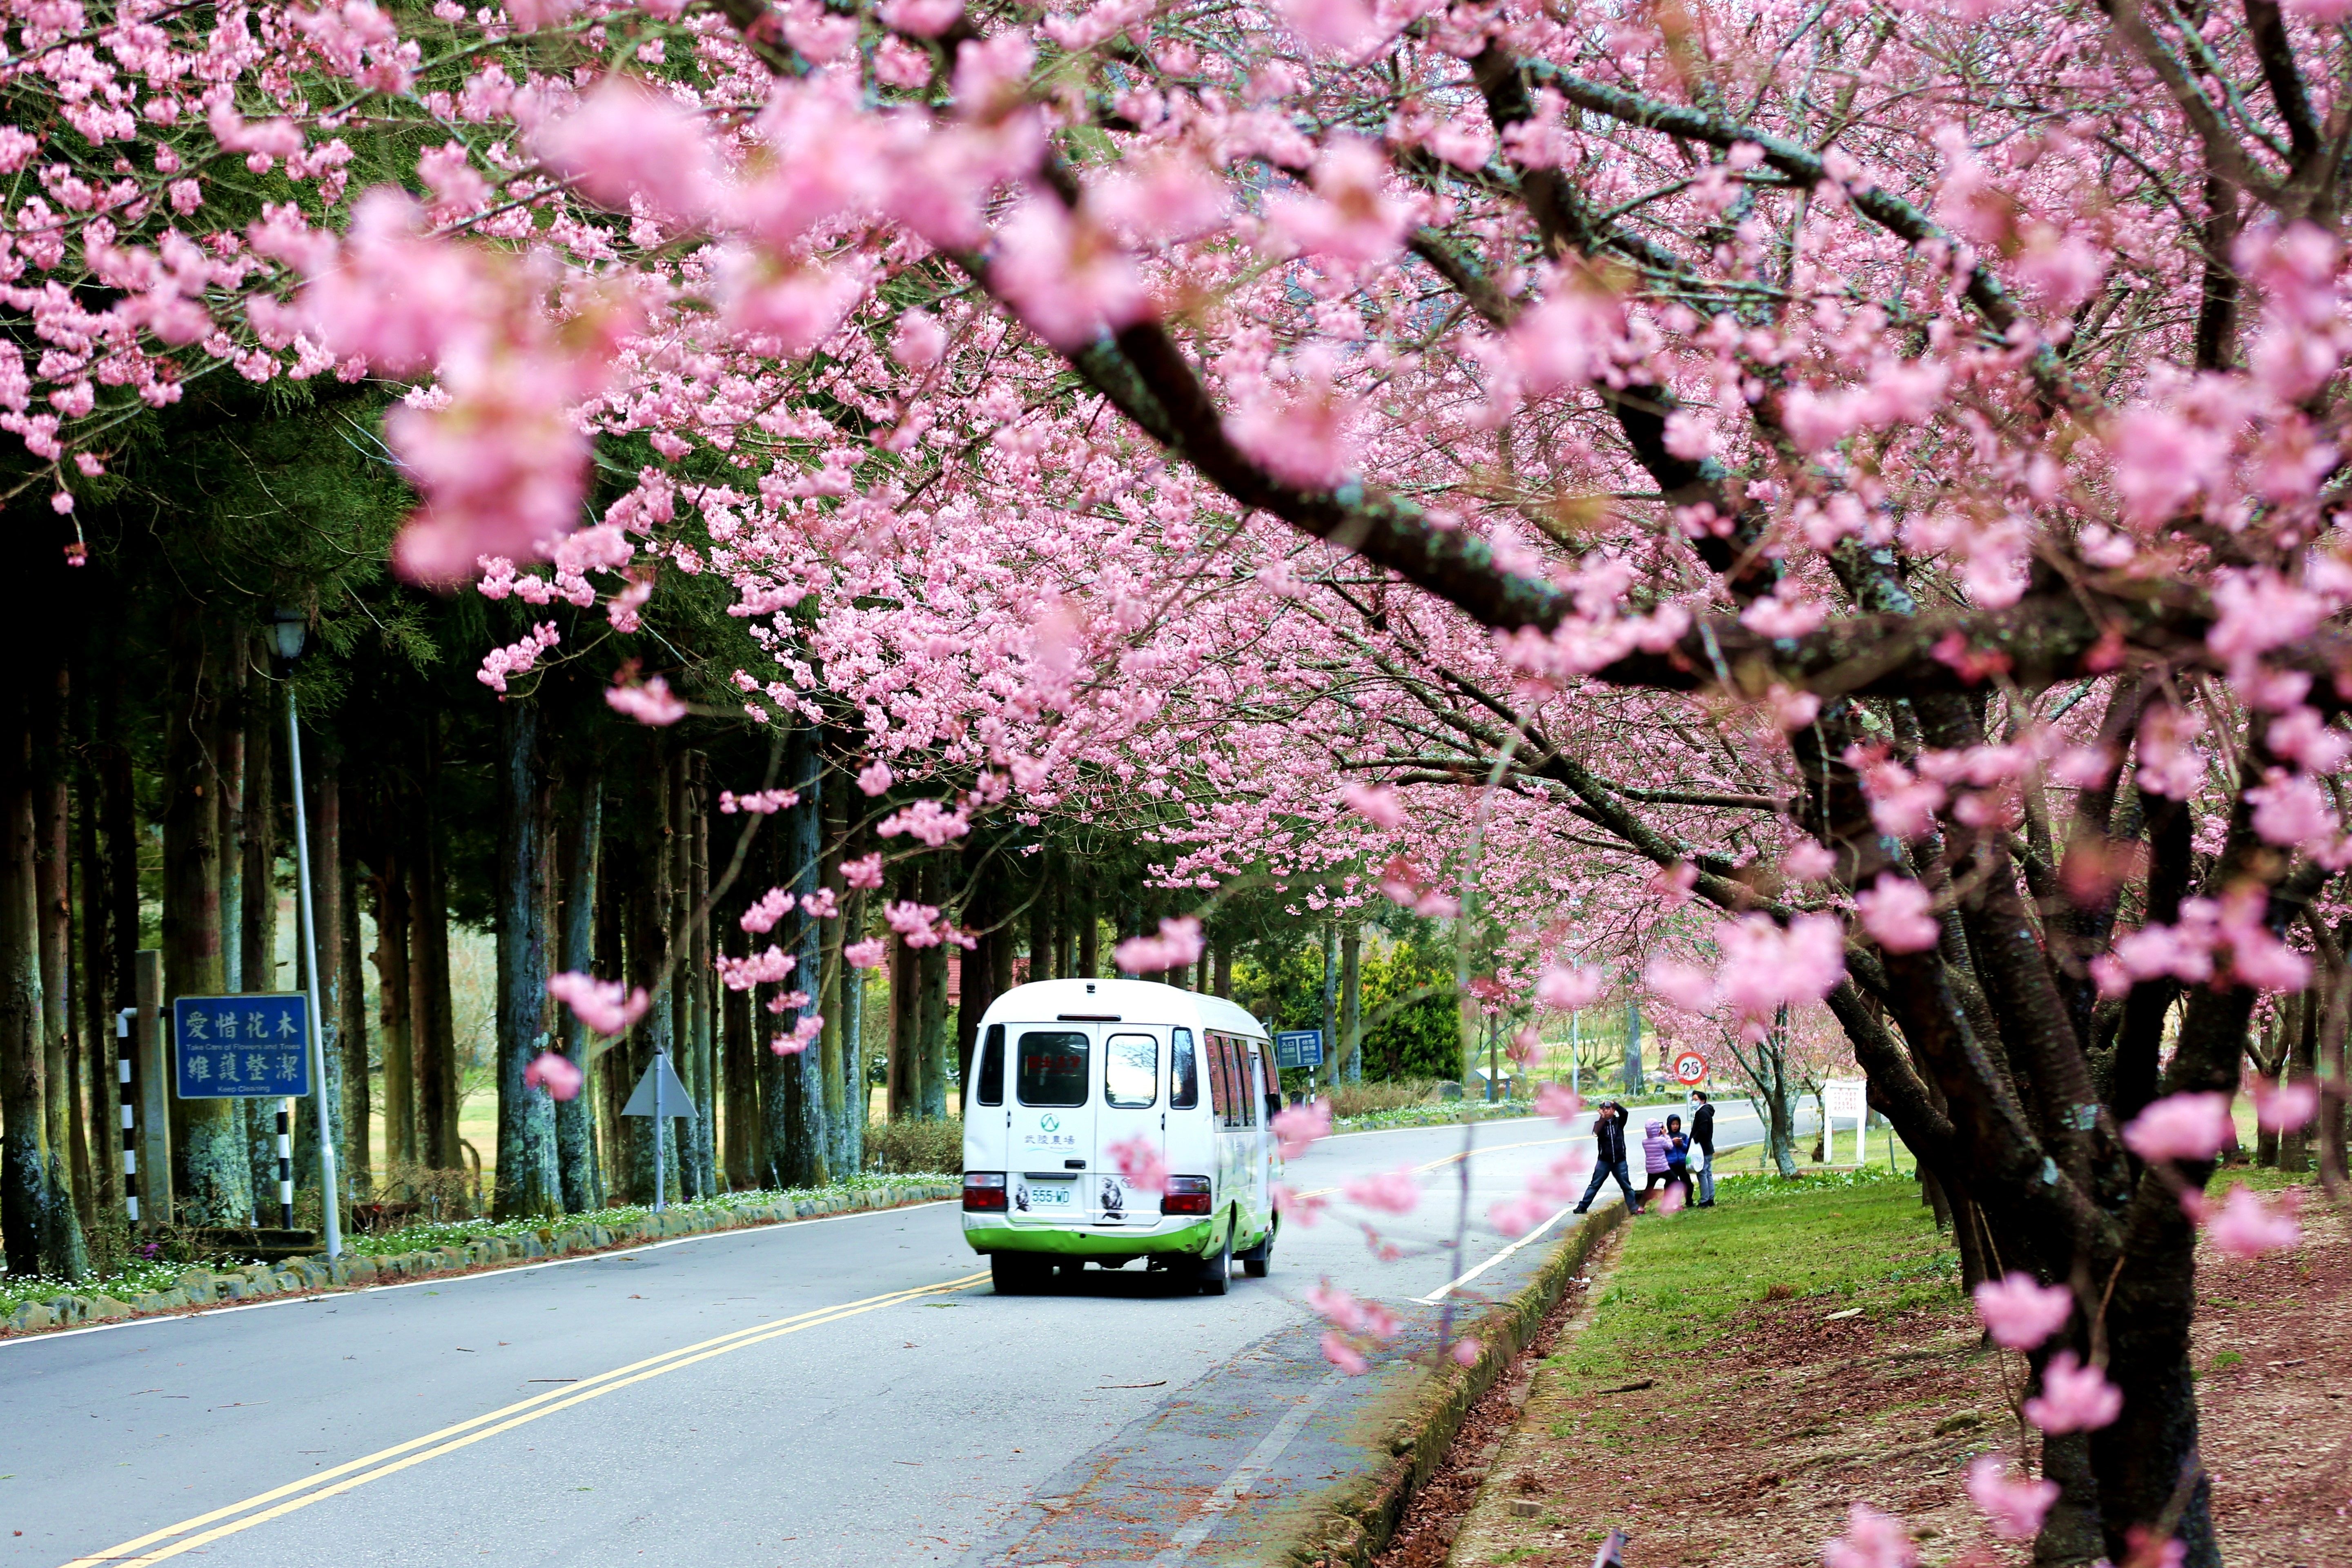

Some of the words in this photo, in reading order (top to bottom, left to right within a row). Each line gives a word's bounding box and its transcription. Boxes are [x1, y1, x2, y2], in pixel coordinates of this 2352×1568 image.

[186, 1011, 298, 1040] 愛惜花木
[187, 1052, 298, 1082] 維護整潔
[1682, 1062, 1699, 1075] 25
[1032, 1190, 1070, 1203] 555-WD
